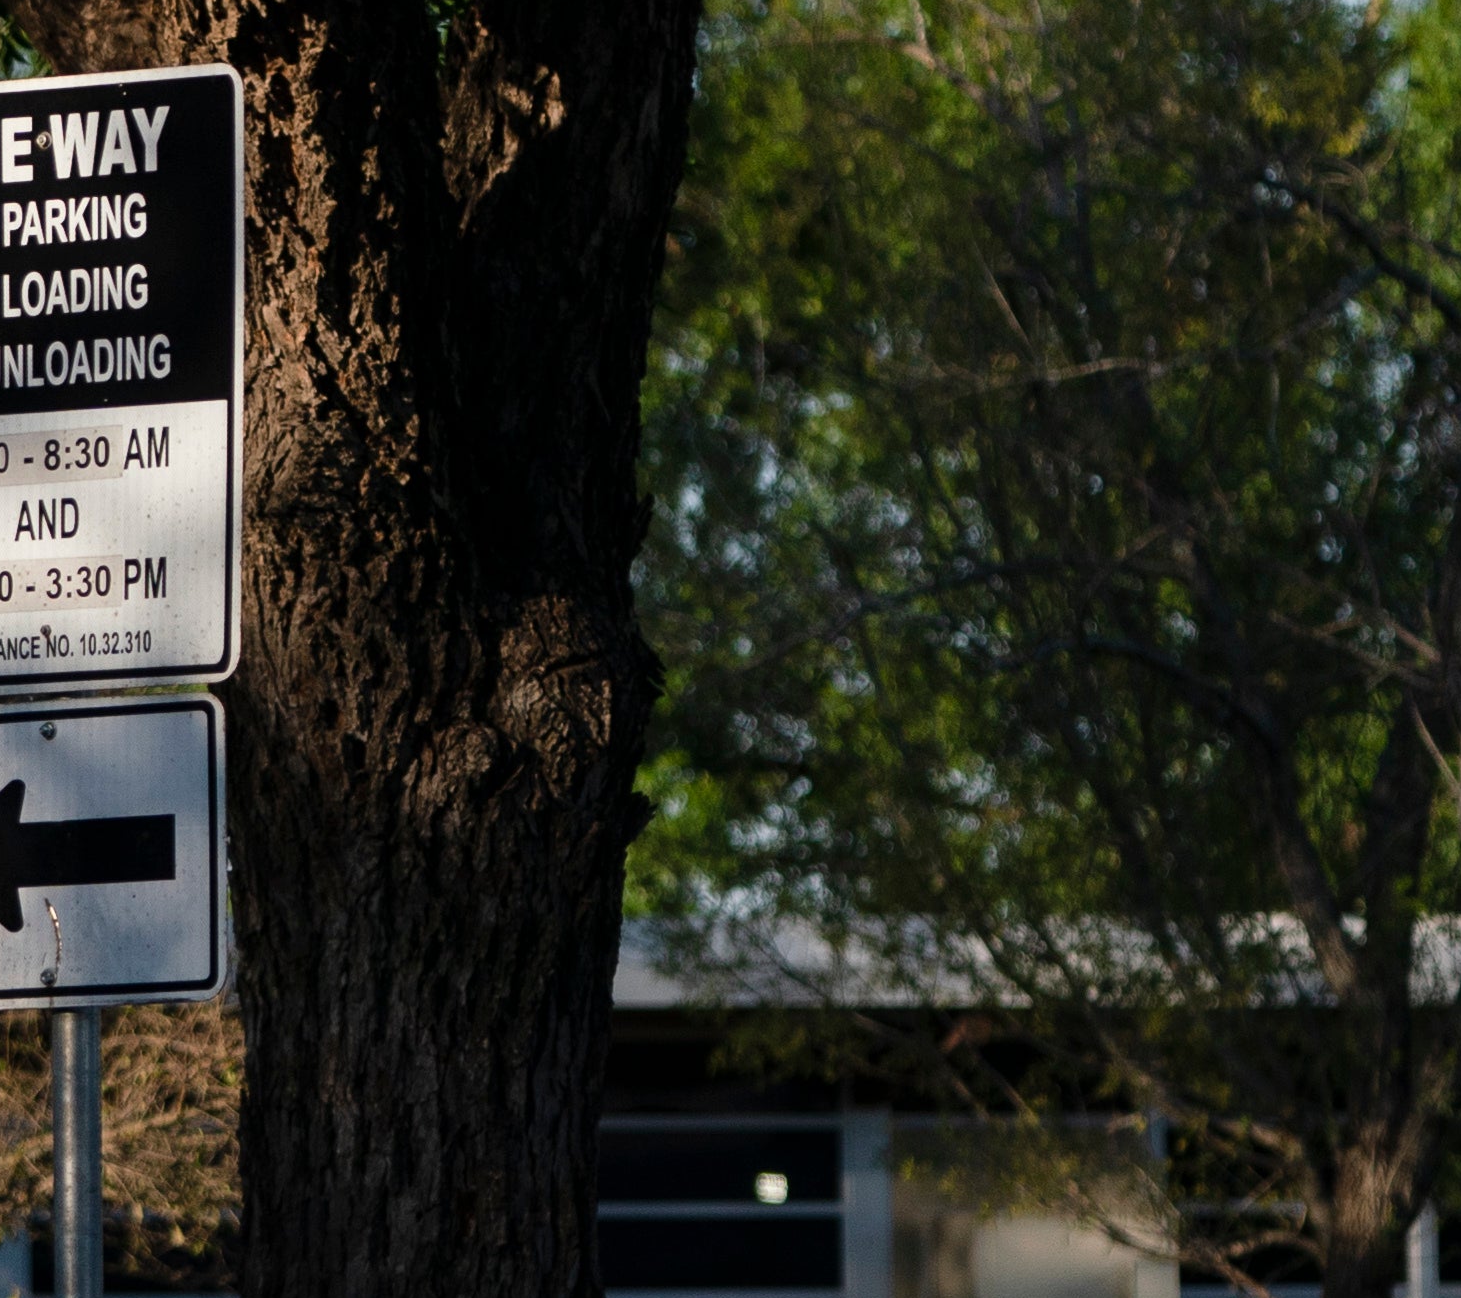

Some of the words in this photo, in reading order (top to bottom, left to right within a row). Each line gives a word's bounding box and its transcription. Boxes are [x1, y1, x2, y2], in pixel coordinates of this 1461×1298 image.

[47, 105, 170, 180] WAY
[2, 192, 147, 247] PARKING
[2, 263, 149, 319] LOADING
[23, 457, 34, 465] -
[43, 436, 110, 472] 8:30
[123, 426, 170, 470] AM
[14, 497, 80, 542] AND
[25, 585, 36, 593] -
[45, 564, 112, 600] 3:30
[124, 556, 167, 600] PM
[45, 634, 75, 660] NO.
[79, 629, 152, 657] 10.32.310
